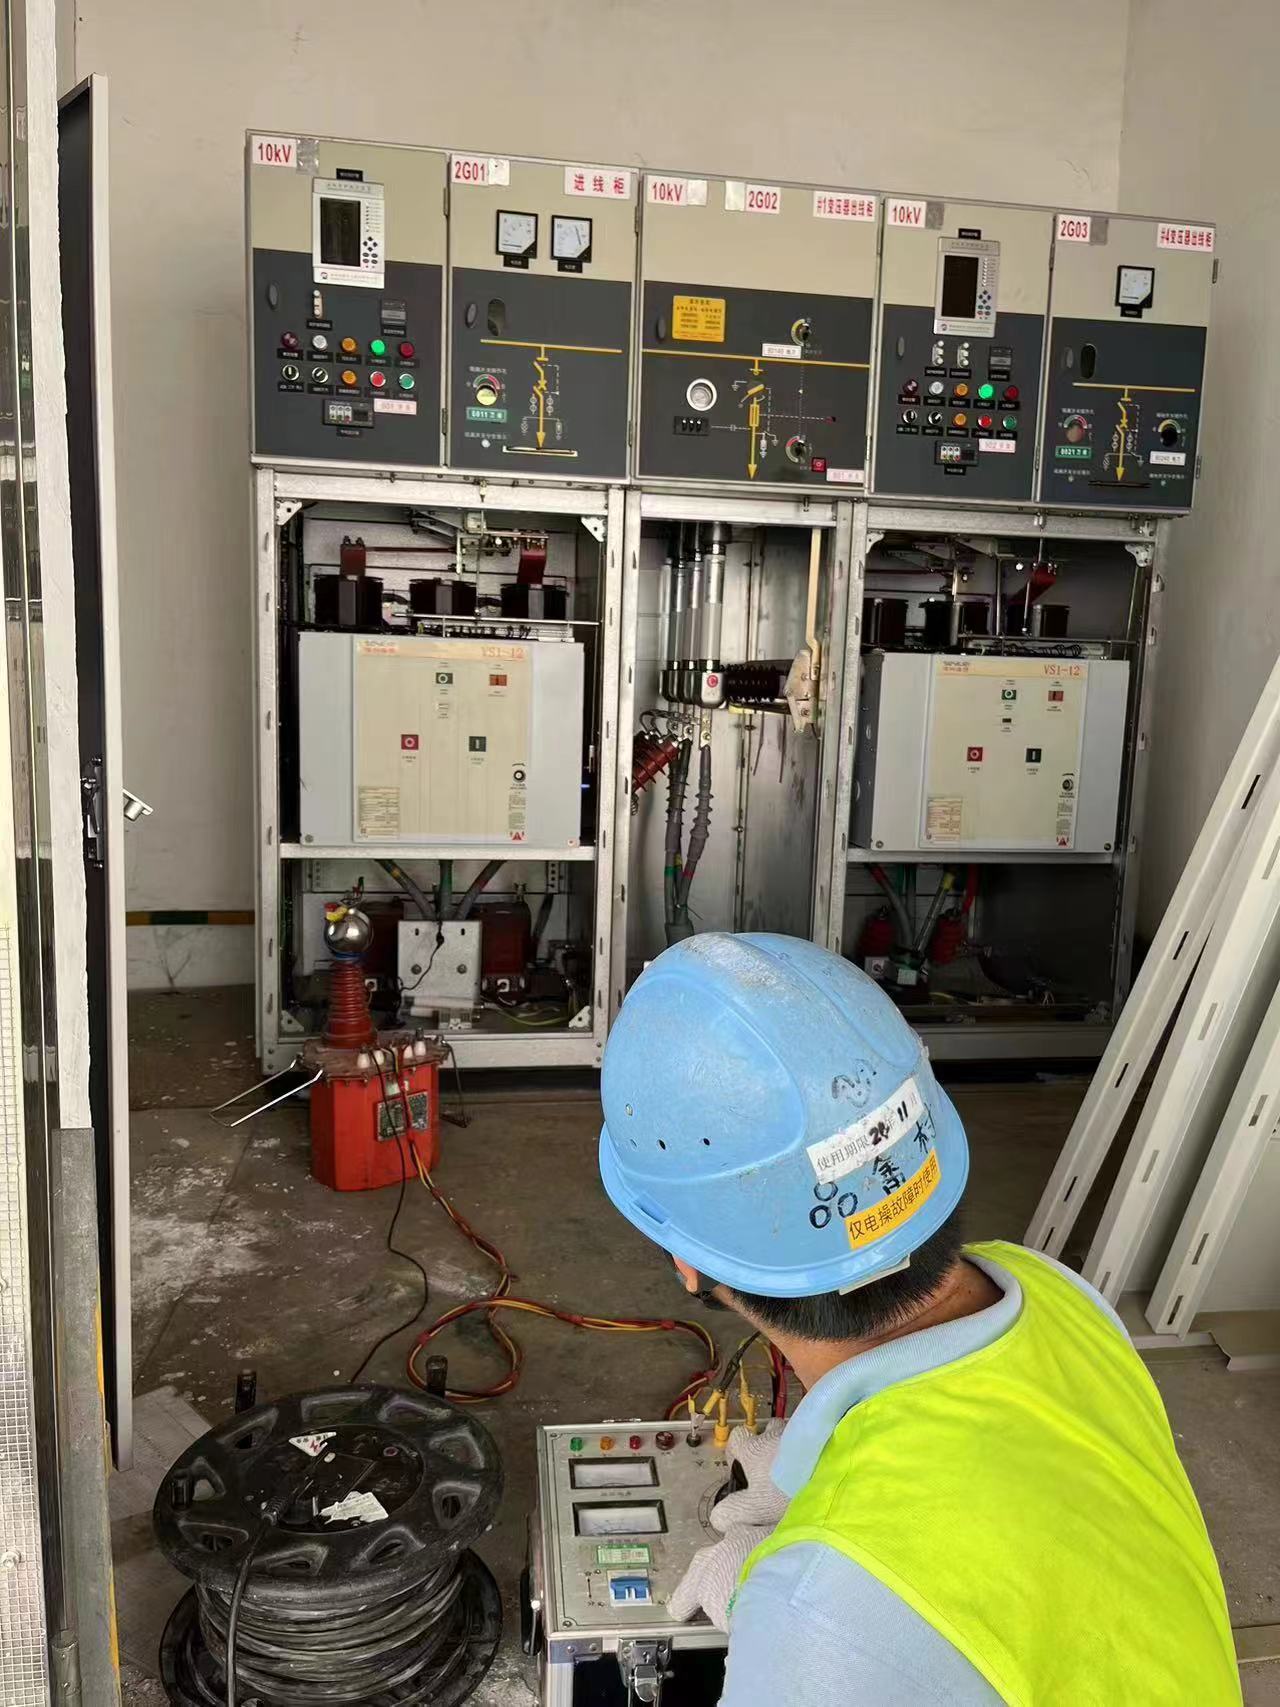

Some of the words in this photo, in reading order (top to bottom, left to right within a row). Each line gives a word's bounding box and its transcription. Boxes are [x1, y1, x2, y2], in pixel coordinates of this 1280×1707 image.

[257, 142, 292, 163] 10kV
[454, 161, 486, 181] 2G01
[651, 182, 684, 202] 10kV
[748, 190, 778, 210] 2G02
[891, 206, 922, 225] 10kV
[1060, 219, 1088, 239] 2G03
[1043, 663, 1081, 676] VS1-12
[848, 1154, 938, 1241] 仅电操故障时使用
